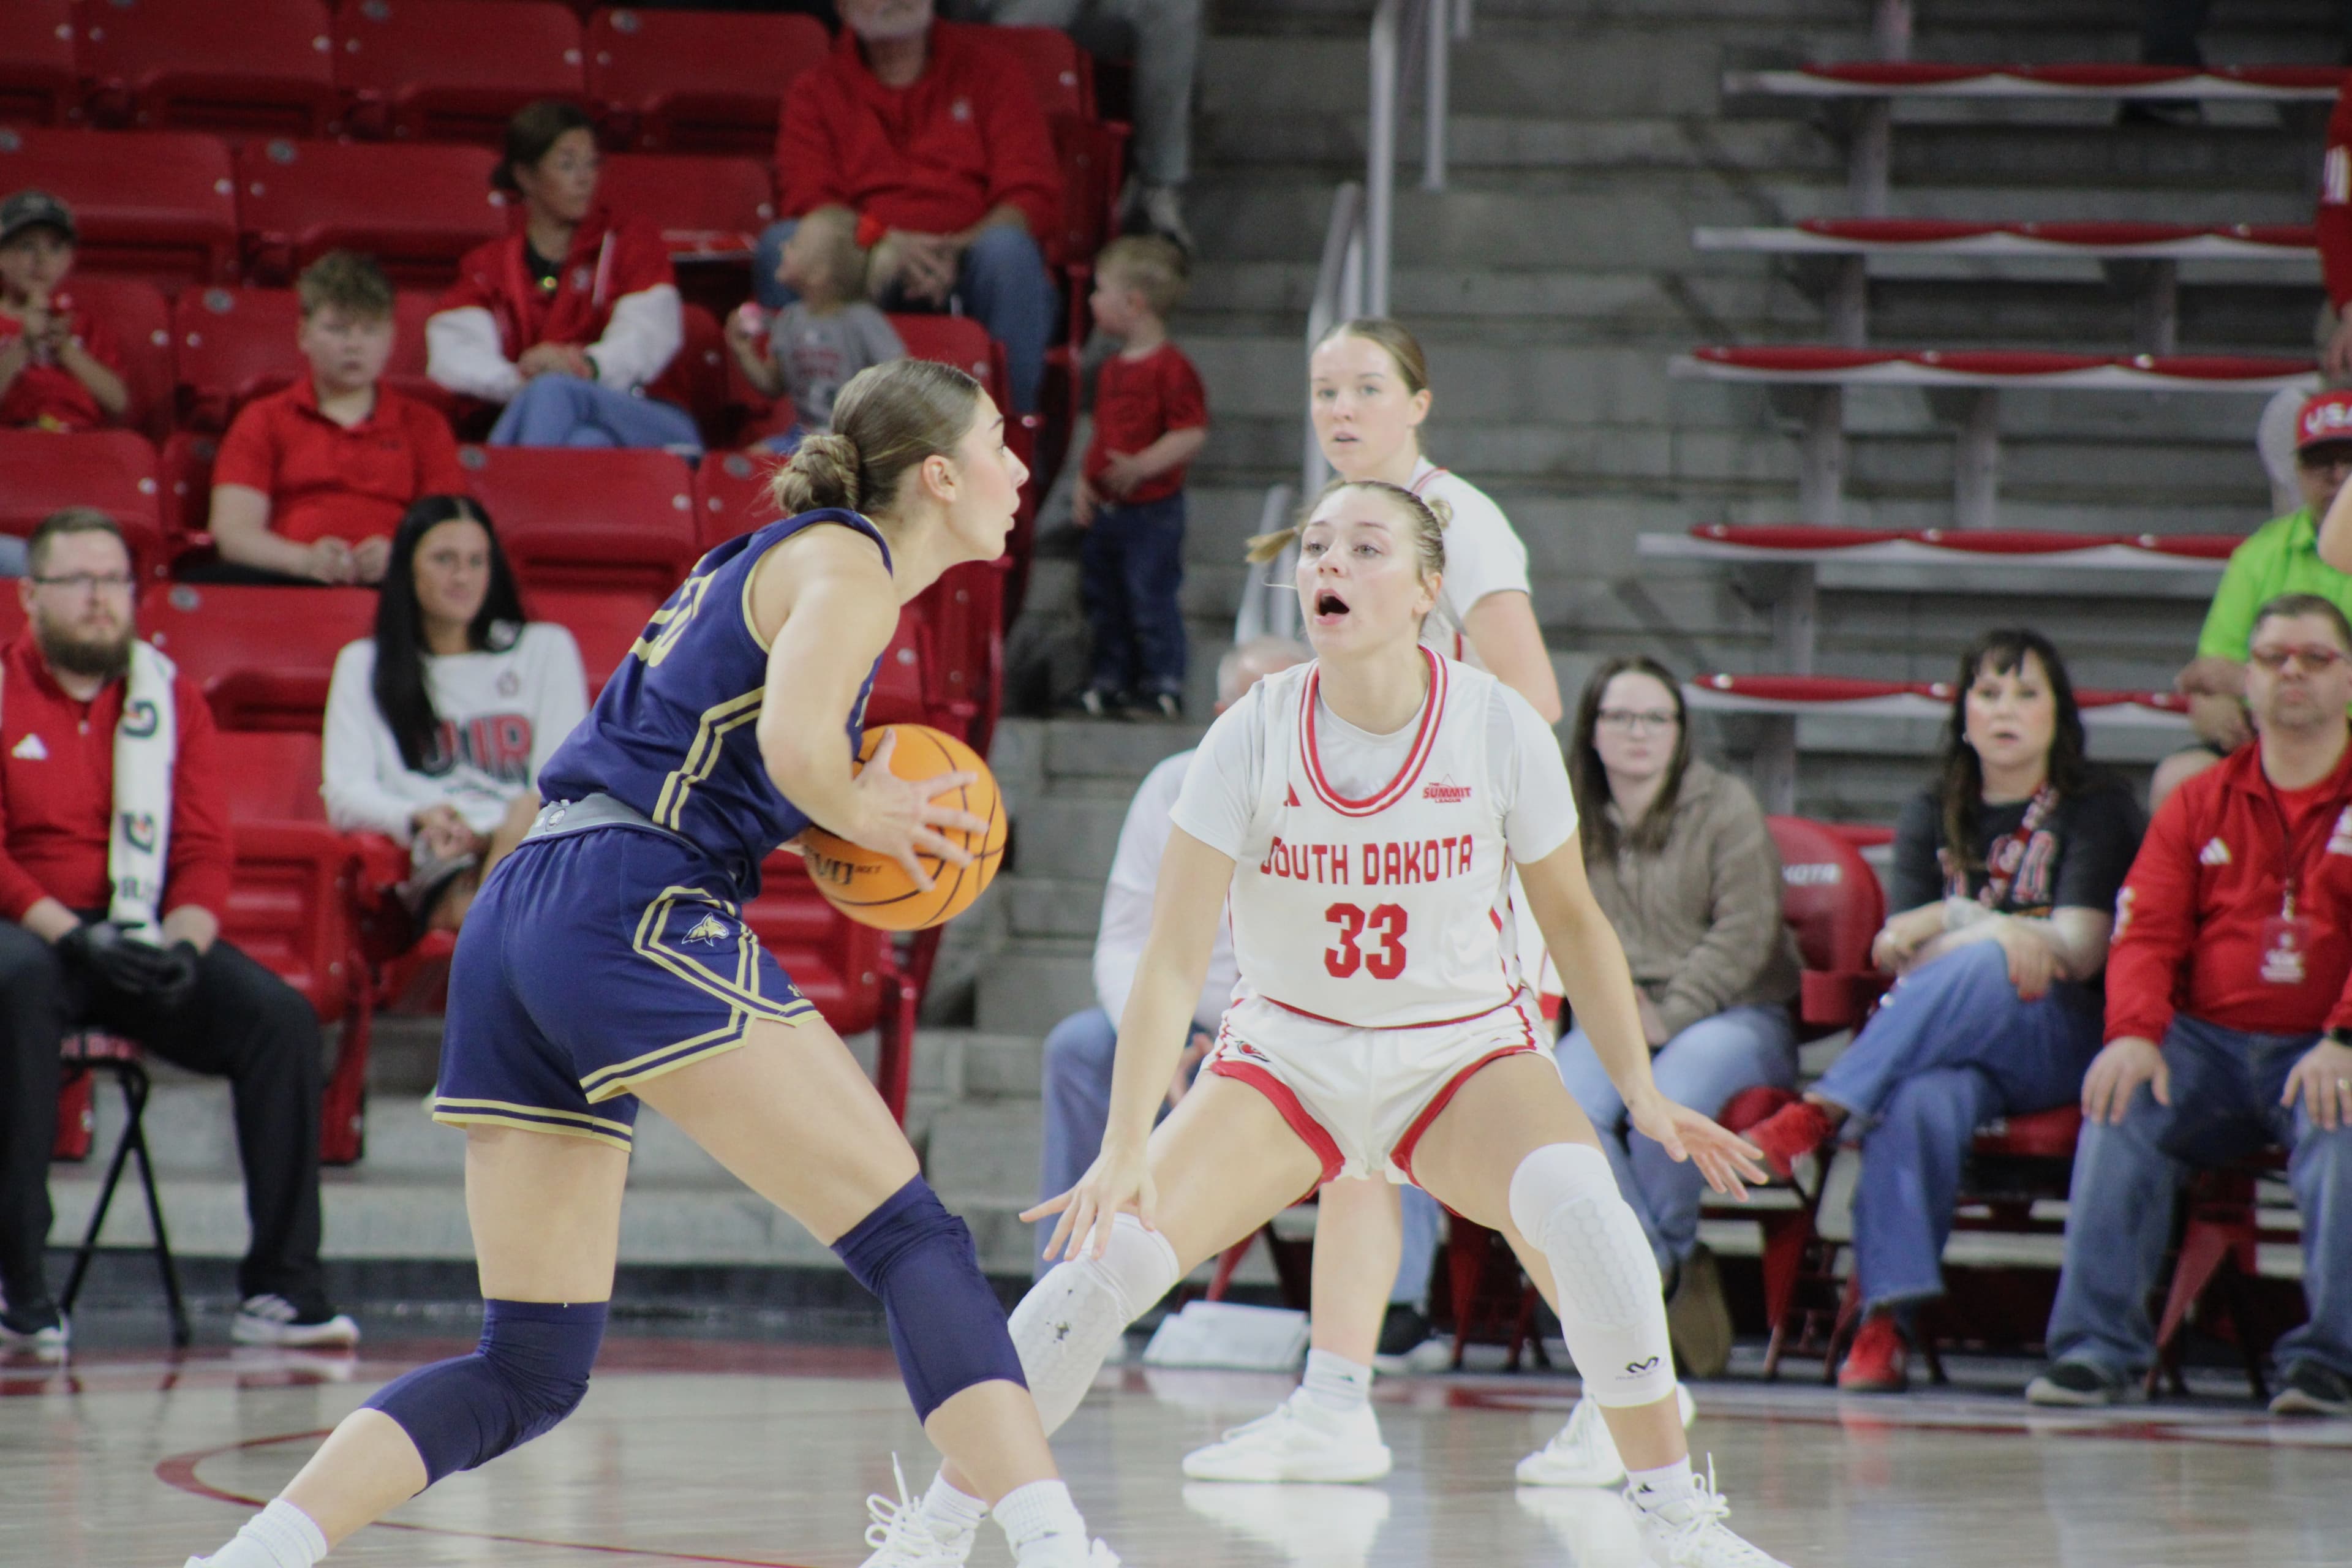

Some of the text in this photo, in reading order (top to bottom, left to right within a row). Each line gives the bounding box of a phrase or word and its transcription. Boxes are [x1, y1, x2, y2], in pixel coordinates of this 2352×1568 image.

[1422, 786, 1472, 799] SUMMIT
[1260, 834, 1473, 886] SOUTH DAKOTA
[1324, 902, 1408, 980] 33
